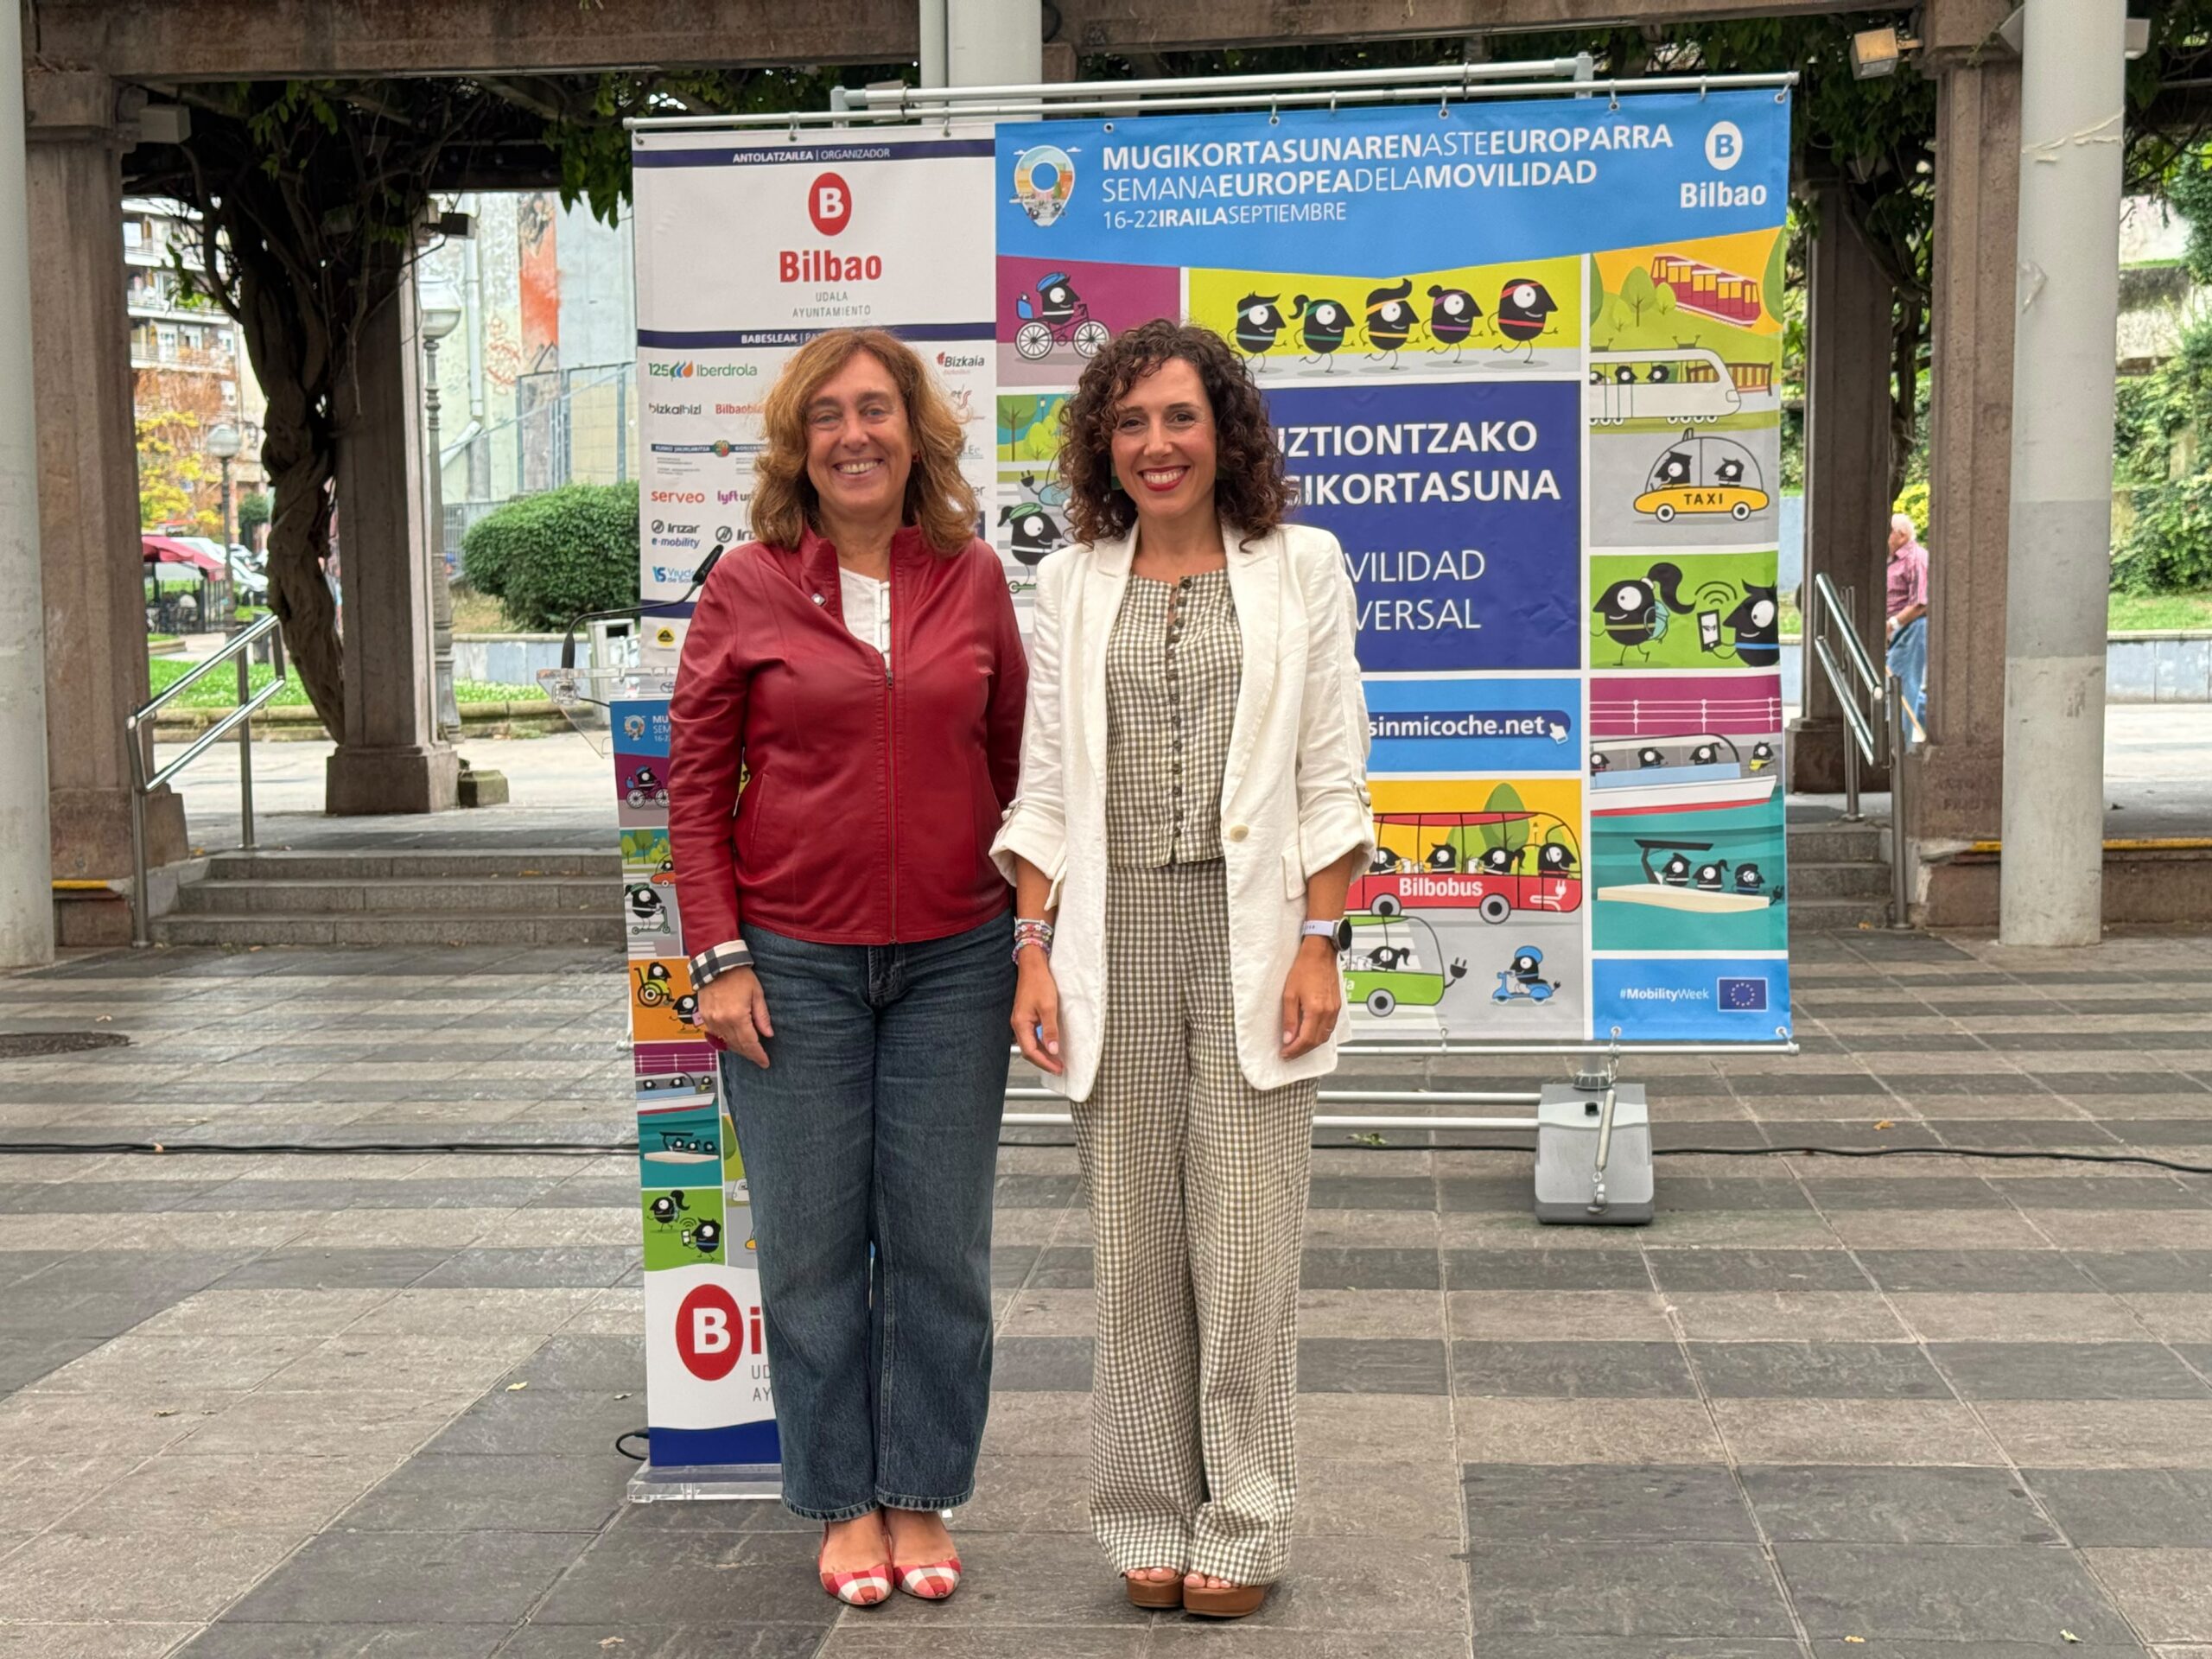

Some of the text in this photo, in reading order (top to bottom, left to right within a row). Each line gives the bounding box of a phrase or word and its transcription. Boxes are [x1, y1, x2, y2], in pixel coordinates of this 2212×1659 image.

[733, 148, 891, 163] ANTOLATZAILEA ORGANIZADOR
[1680, 181, 1768, 209] Bilbao
[779, 250, 882, 283] Bilbao
[816, 292, 849, 302] UDALA
[792, 305, 872, 318] AYUNTAMIENTO
[741, 334, 798, 344] BABESLEAK
[944, 356, 985, 367] Bizkaia
[649, 363, 758, 377] 125 Iberdrola
[651, 490, 705, 504] serveo
[717, 490, 739, 505] lyft
[1683, 493, 1723, 505] TAXI
[1344, 550, 1485, 582] VILIDAD
[1399, 877, 1484, 897] Bilbobus
[1619, 988, 1710, 1002] #MobilityWeek
